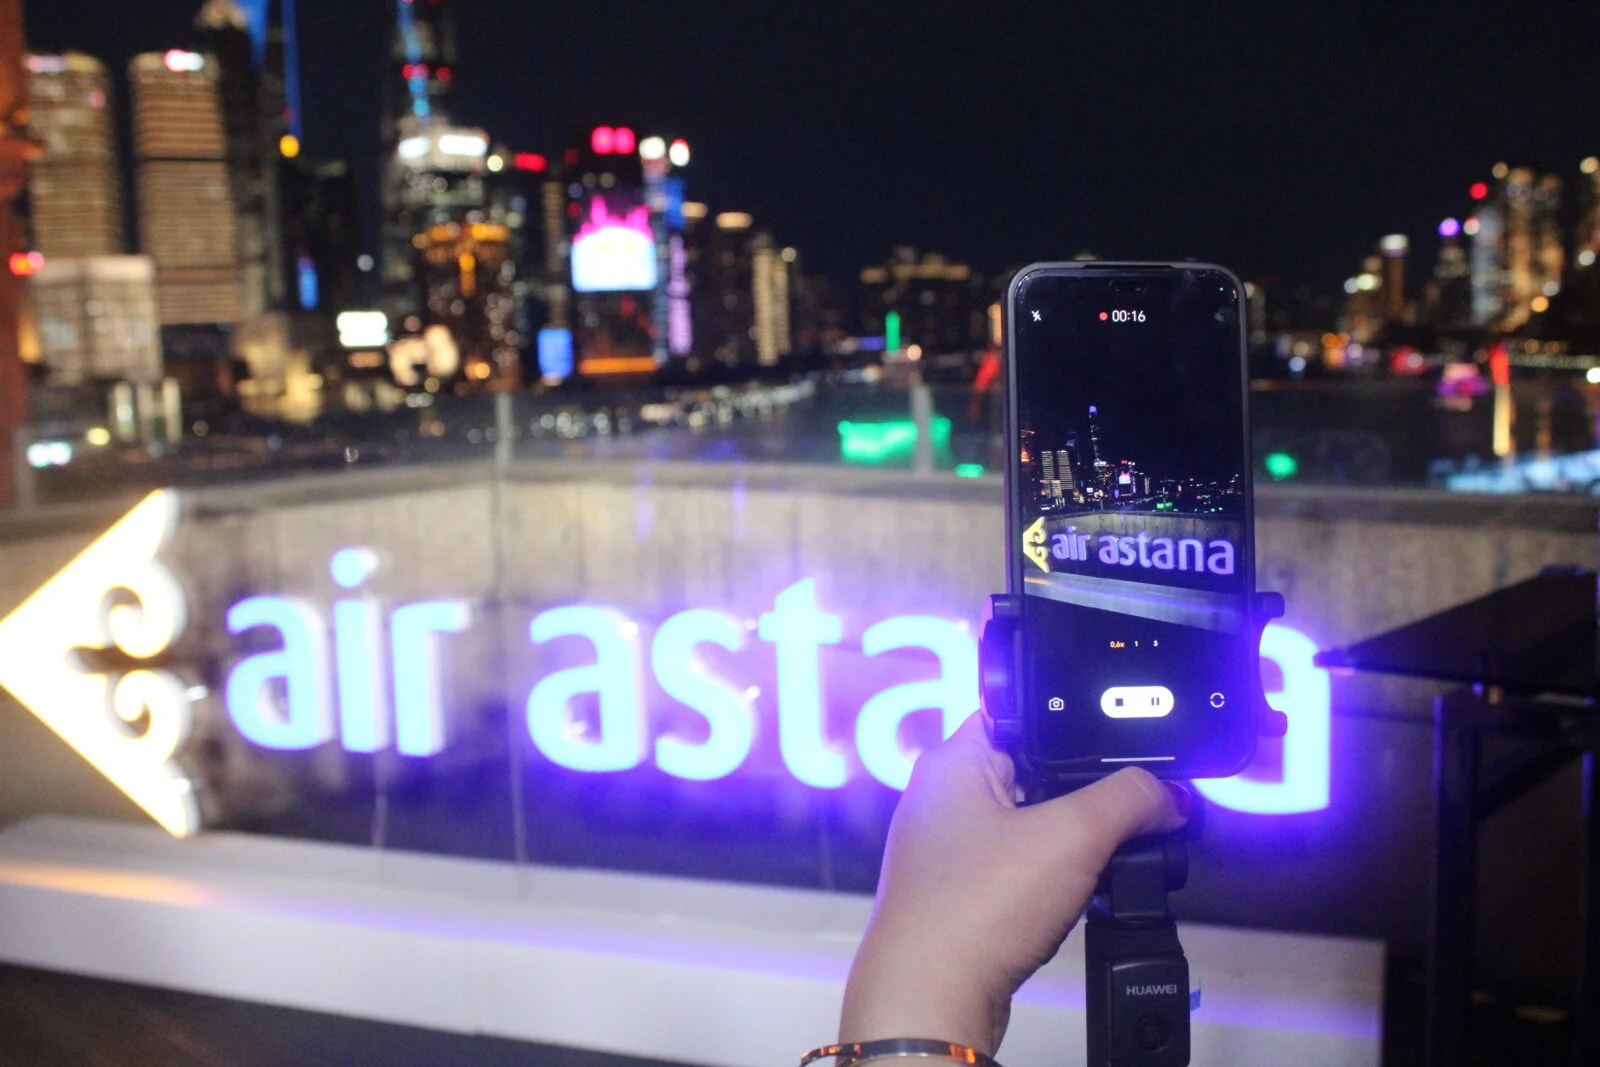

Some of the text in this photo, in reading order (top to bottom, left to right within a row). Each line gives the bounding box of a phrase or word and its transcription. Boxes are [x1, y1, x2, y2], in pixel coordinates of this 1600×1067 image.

[1112, 310, 1146, 322] 00:16
[1052, 525, 1235, 575] air astana
[226, 547, 1331, 815] air astaa
[1126, 984, 1177, 996] HUAWEI
